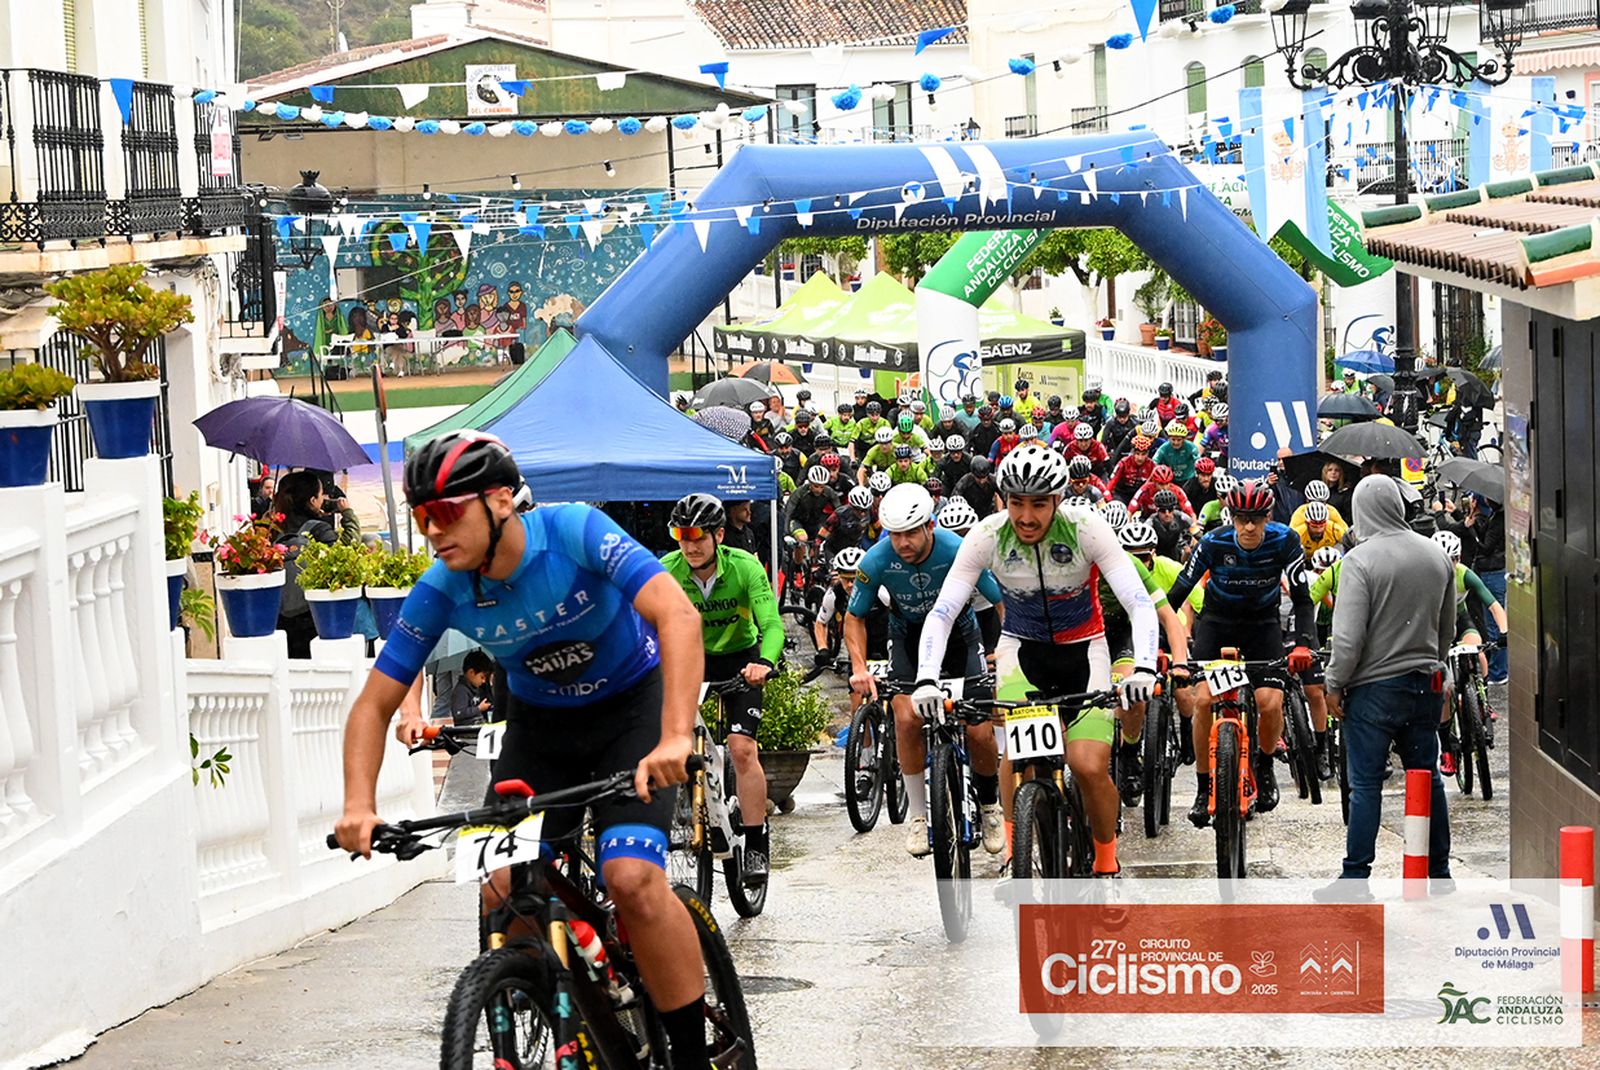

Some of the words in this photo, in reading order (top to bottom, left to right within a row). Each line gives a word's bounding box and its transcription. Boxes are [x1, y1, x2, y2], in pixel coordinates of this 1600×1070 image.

[856, 213, 959, 230] Diputación
[964, 209, 1056, 226] Provincial
[964, 232, 1023, 299] ANDALUZA
[987, 271, 1004, 289] DE
[475, 589, 590, 639] FASTER
[532, 648, 594, 675] MIJAS
[1209, 665, 1243, 690] 113
[484, 729, 497, 754] 1
[1010, 722, 1057, 753] 110
[473, 829, 519, 871] 74
